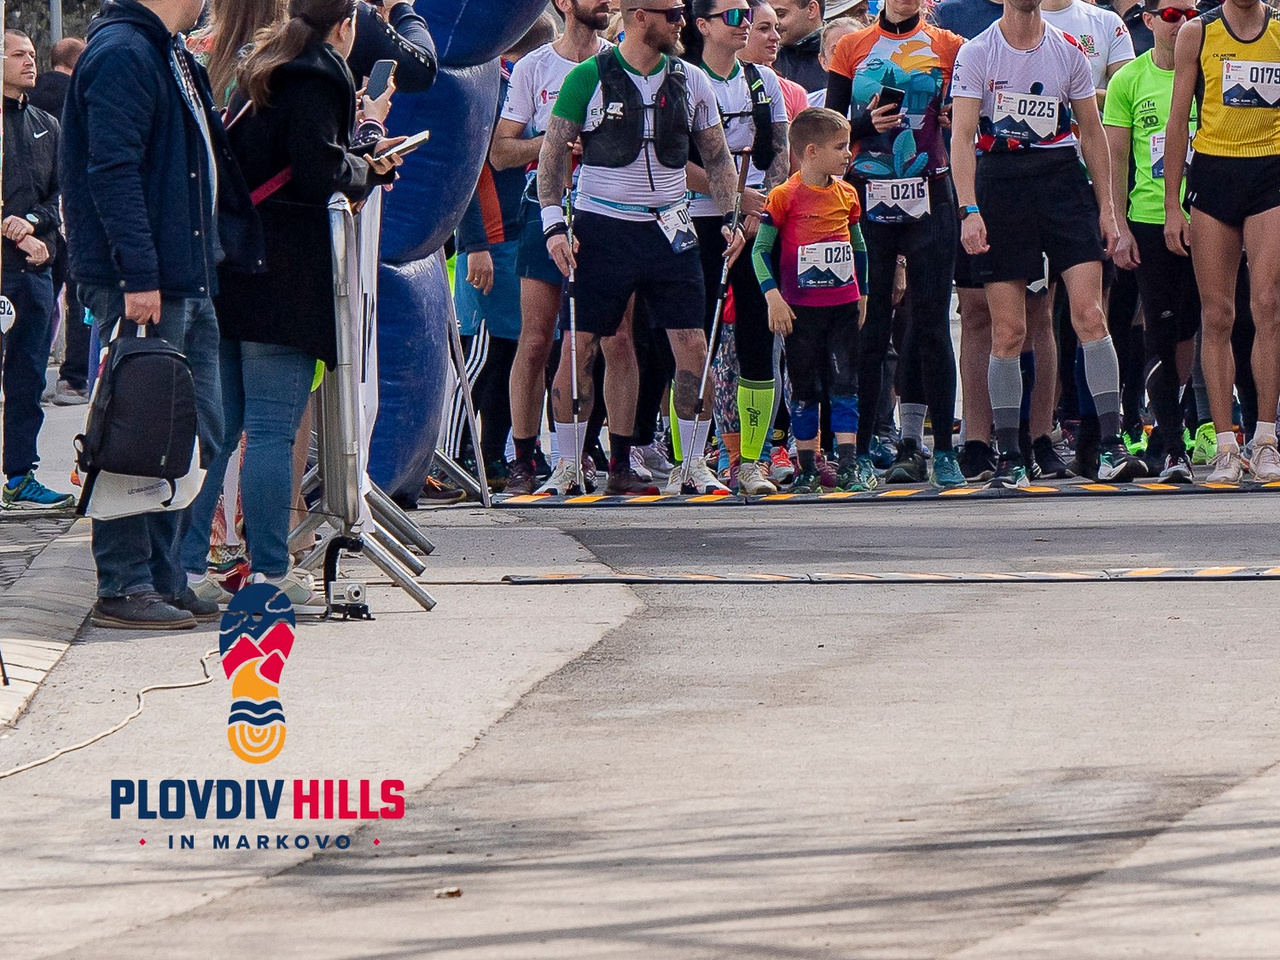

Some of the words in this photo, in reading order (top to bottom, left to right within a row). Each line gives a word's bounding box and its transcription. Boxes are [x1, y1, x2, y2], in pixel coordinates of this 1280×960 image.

[1017, 99, 1056, 119] 0225
[890, 182, 926, 201] 0216
[824, 245, 851, 264] 0215
